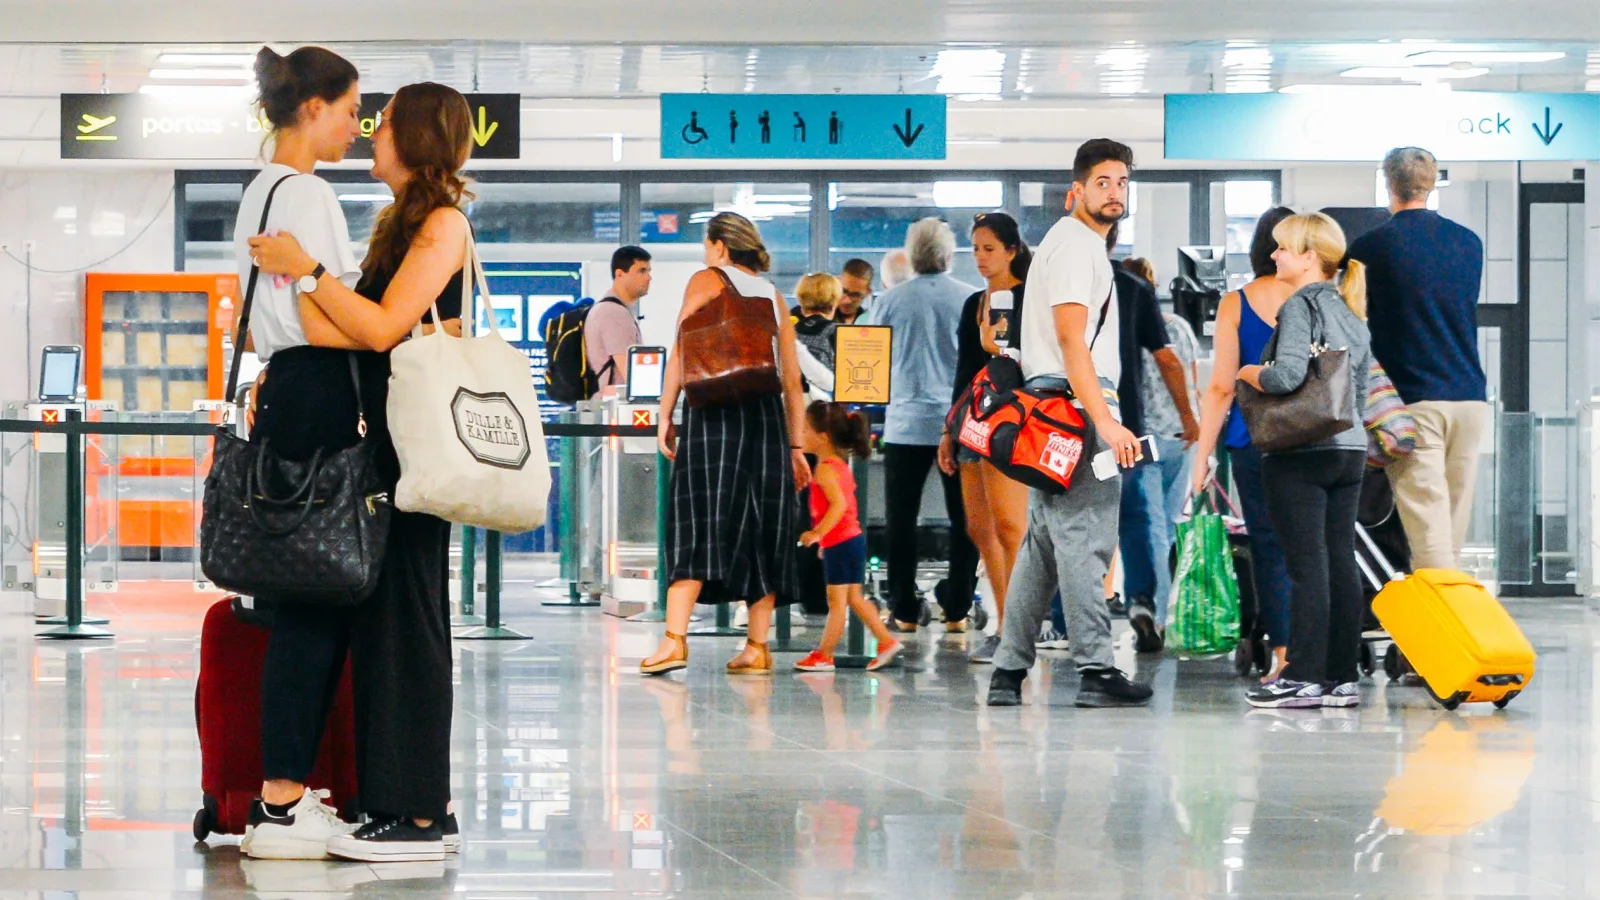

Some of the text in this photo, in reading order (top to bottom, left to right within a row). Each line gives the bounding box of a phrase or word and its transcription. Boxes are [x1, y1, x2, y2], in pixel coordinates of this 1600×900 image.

[142, 115, 224, 138] portas
[465, 409, 514, 430] DILLE &
[465, 424, 520, 446] KAMILLE
[960, 426, 987, 449] FITNESS
[1046, 440, 1080, 460] FITNESS
